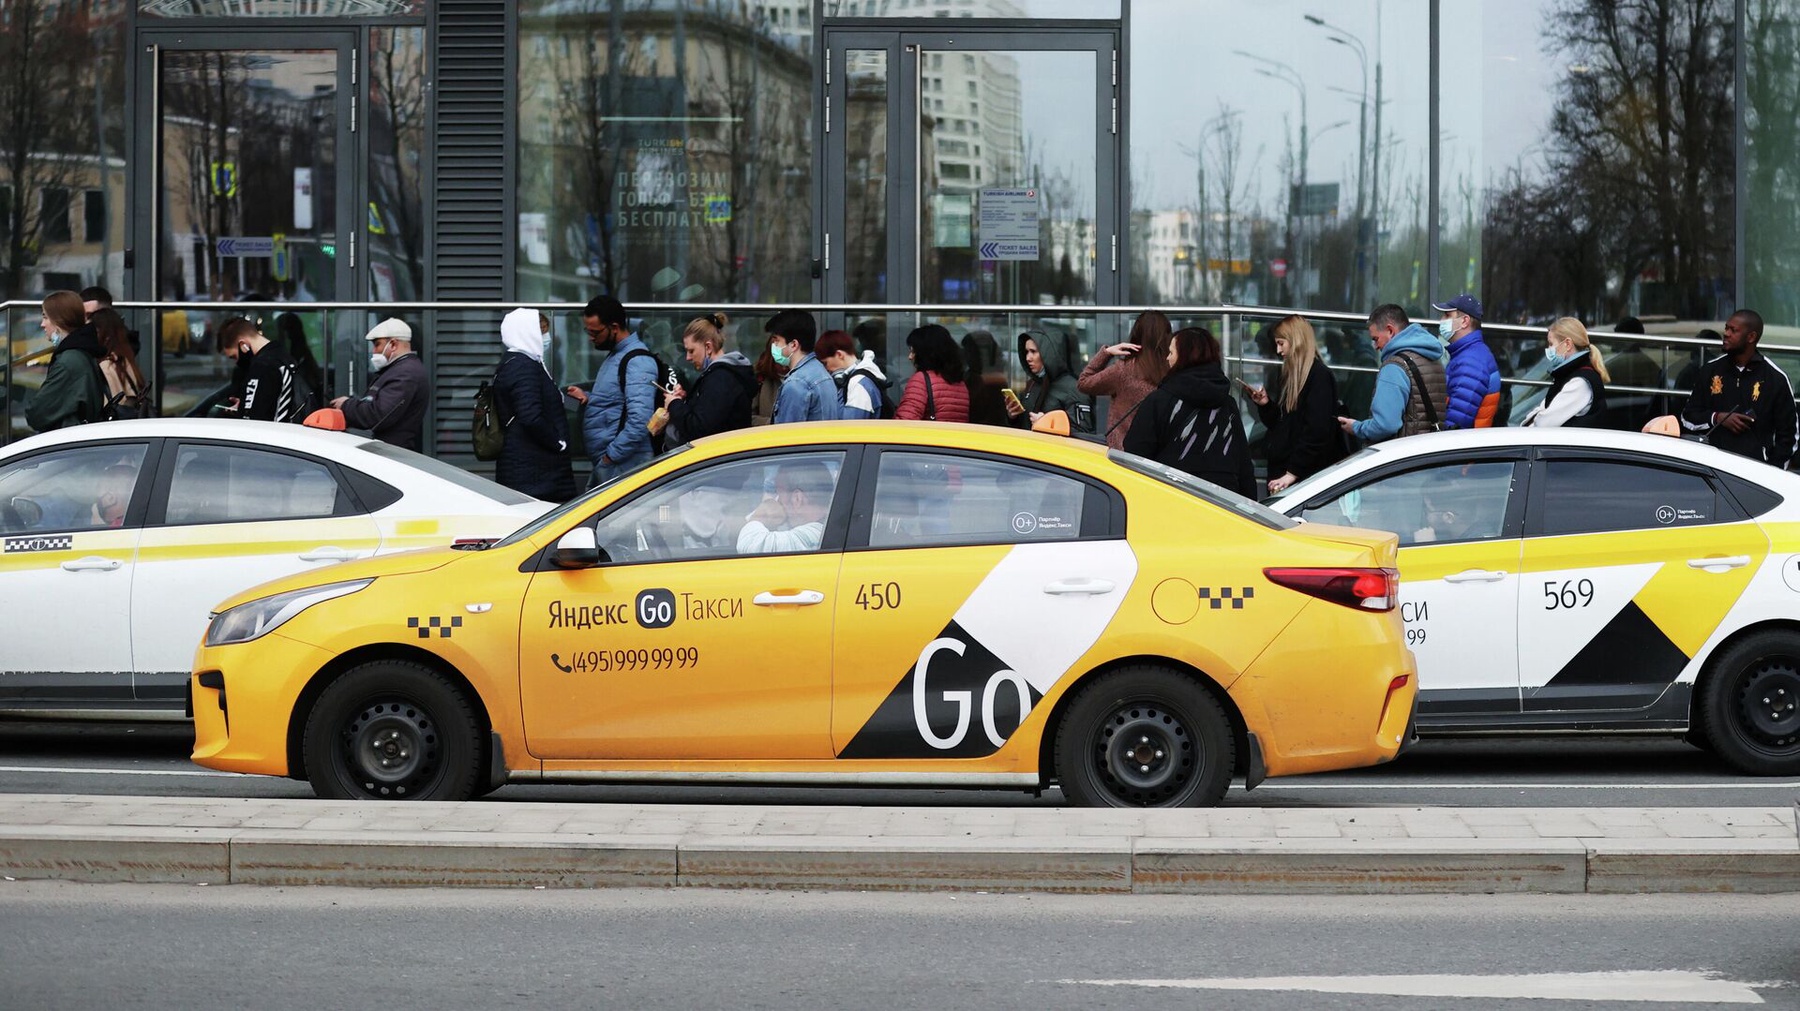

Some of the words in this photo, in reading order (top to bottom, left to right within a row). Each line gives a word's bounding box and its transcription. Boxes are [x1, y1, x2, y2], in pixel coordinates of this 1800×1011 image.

[548, 600, 629, 630] Яндекс
[638, 593, 673, 625] Go
[680, 592, 743, 621] Такси
[855, 581, 902, 611] 450
[1544, 578, 1594, 611] 569
[912, 636, 1033, 750] Go
